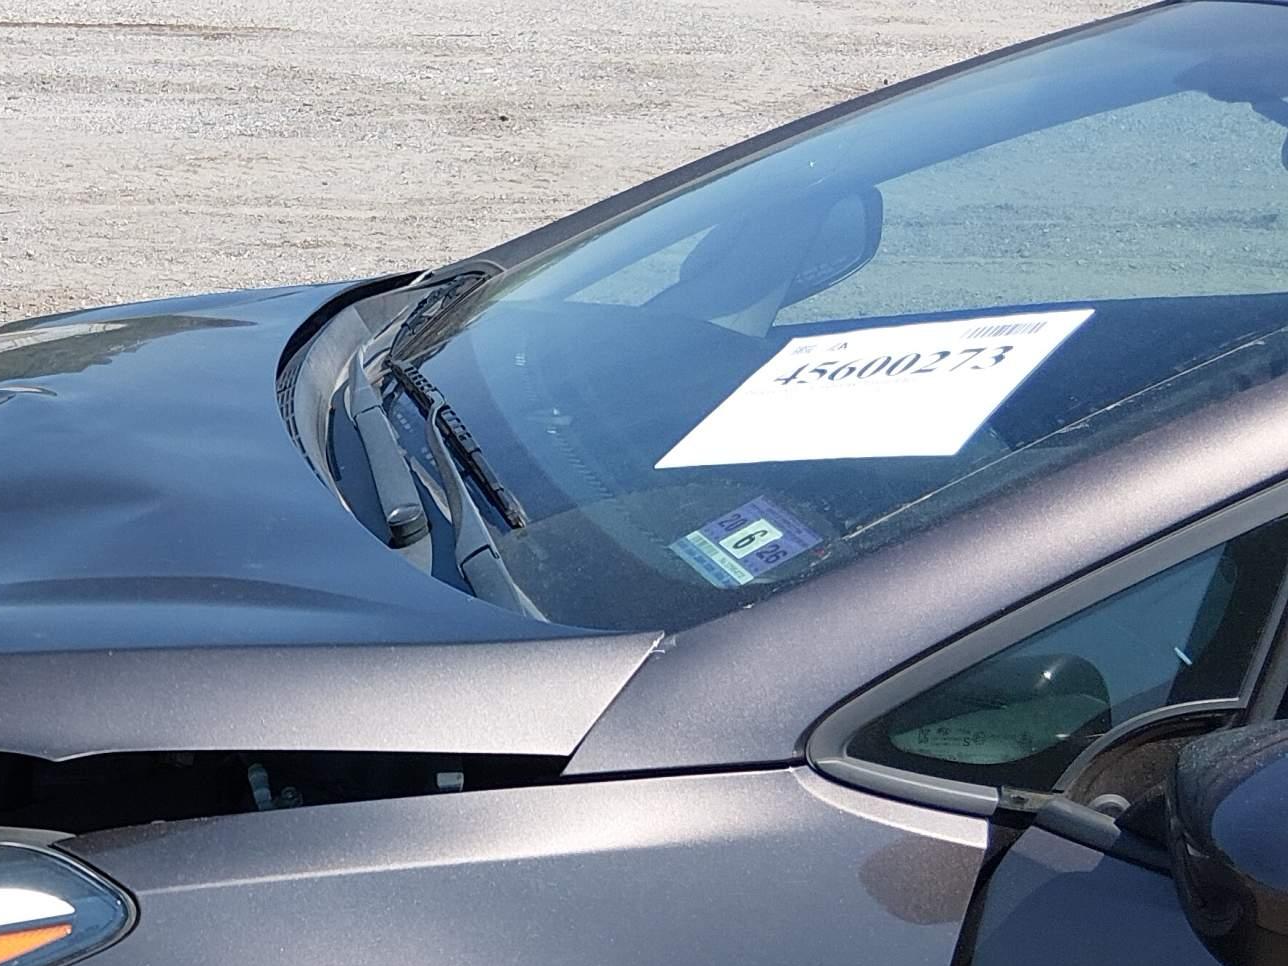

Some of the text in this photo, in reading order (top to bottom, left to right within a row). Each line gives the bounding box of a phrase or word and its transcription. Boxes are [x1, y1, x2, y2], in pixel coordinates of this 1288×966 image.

[774, 345, 1014, 386] 45600273
[719, 513, 748, 532] 20
[732, 529, 768, 549] 6
[756, 544, 788, 564] 26
